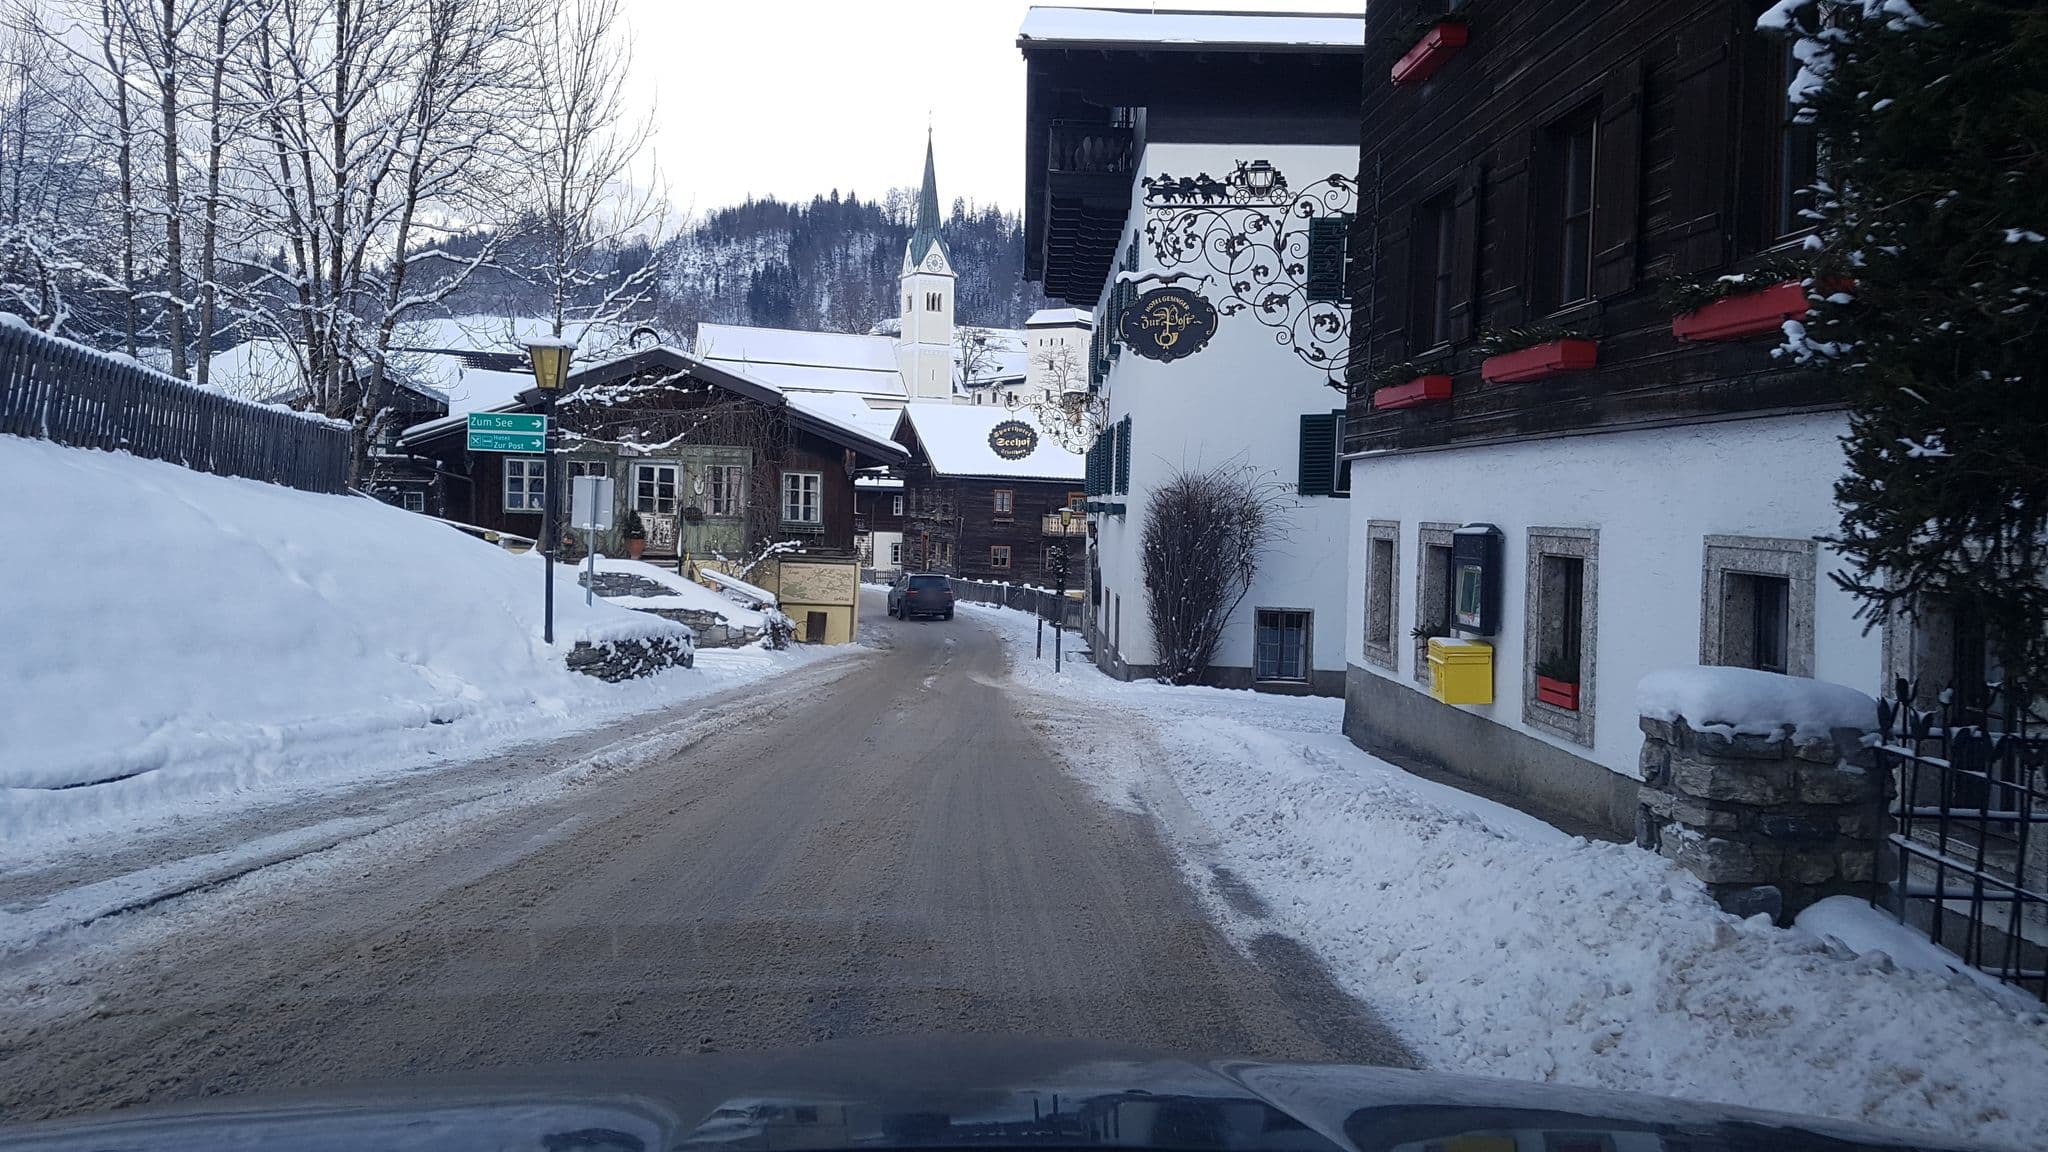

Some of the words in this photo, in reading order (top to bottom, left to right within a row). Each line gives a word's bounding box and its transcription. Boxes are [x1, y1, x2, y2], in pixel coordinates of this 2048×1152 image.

[1144, 297, 1162, 312] HOTEL
[1141, 315, 1160, 329] Zur
[470, 416, 492, 426] Zum
[495, 417, 513, 428] See
[493, 441, 506, 449] Zur
[508, 442, 524, 450] Post
[996, 437, 1031, 448] Seehof
